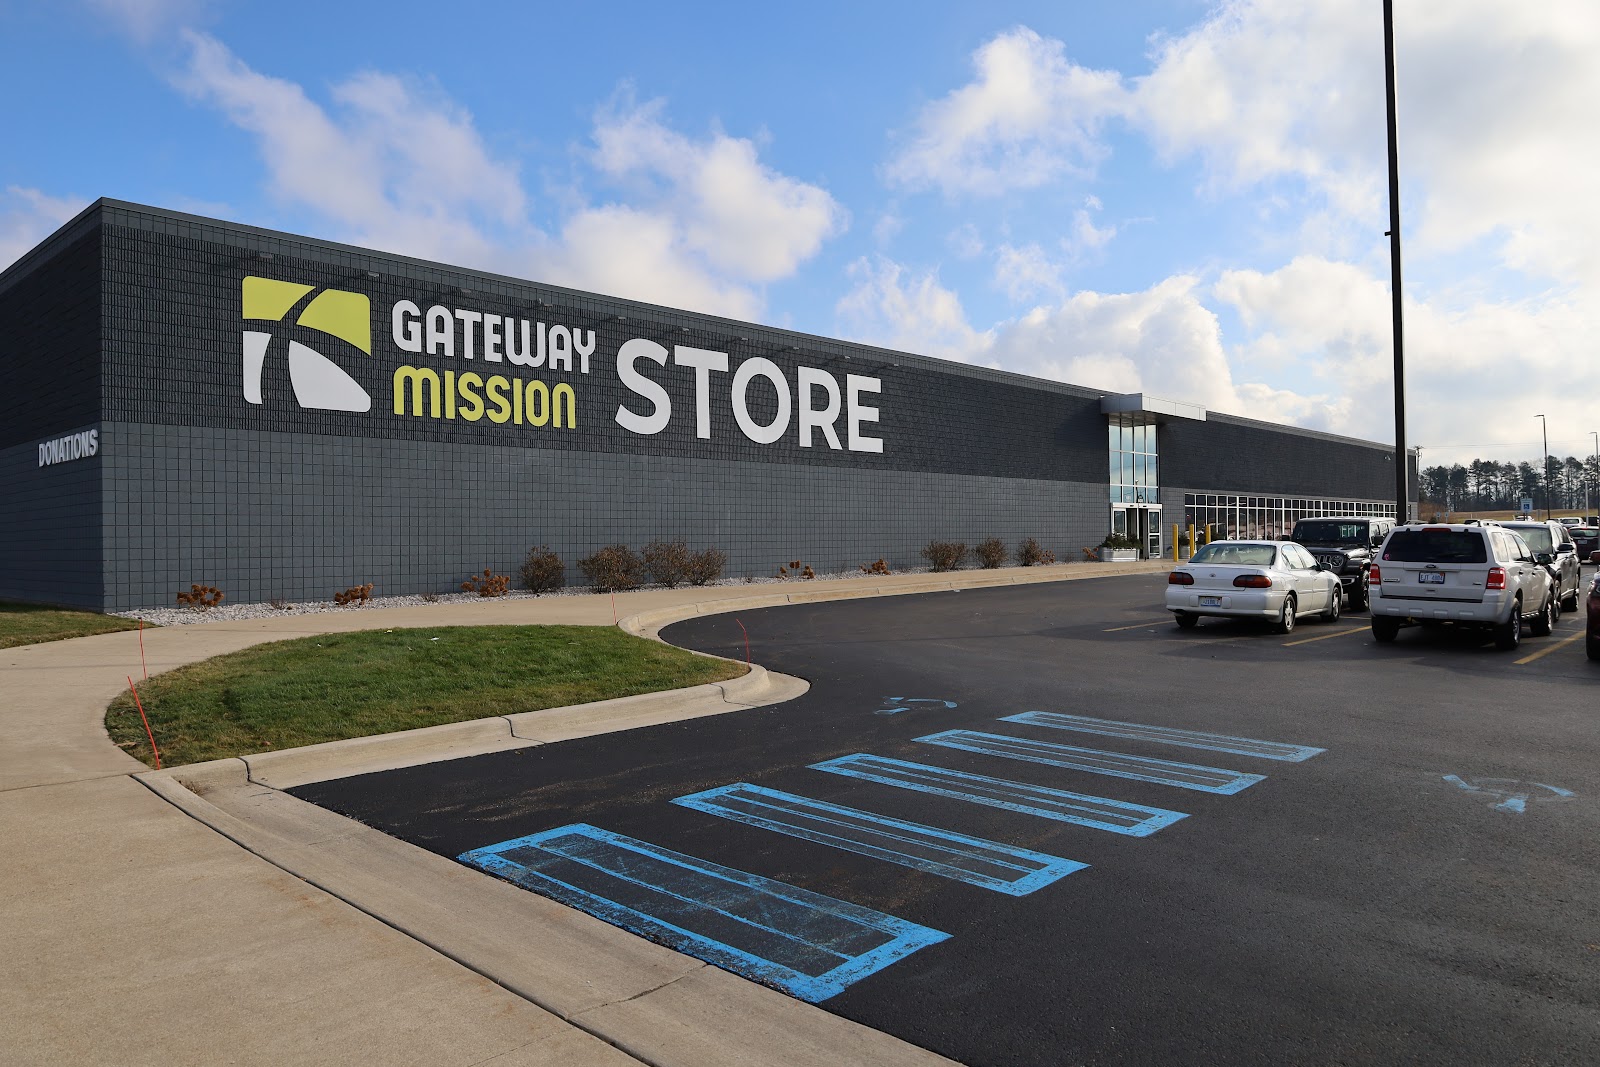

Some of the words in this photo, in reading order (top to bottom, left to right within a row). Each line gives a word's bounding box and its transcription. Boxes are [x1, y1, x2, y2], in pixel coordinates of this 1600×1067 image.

[391, 299, 596, 374] GATEWAY
[392, 365, 577, 430] MISSION
[614, 337, 884, 454] STORE
[38, 429, 98, 467] DONATIONS
